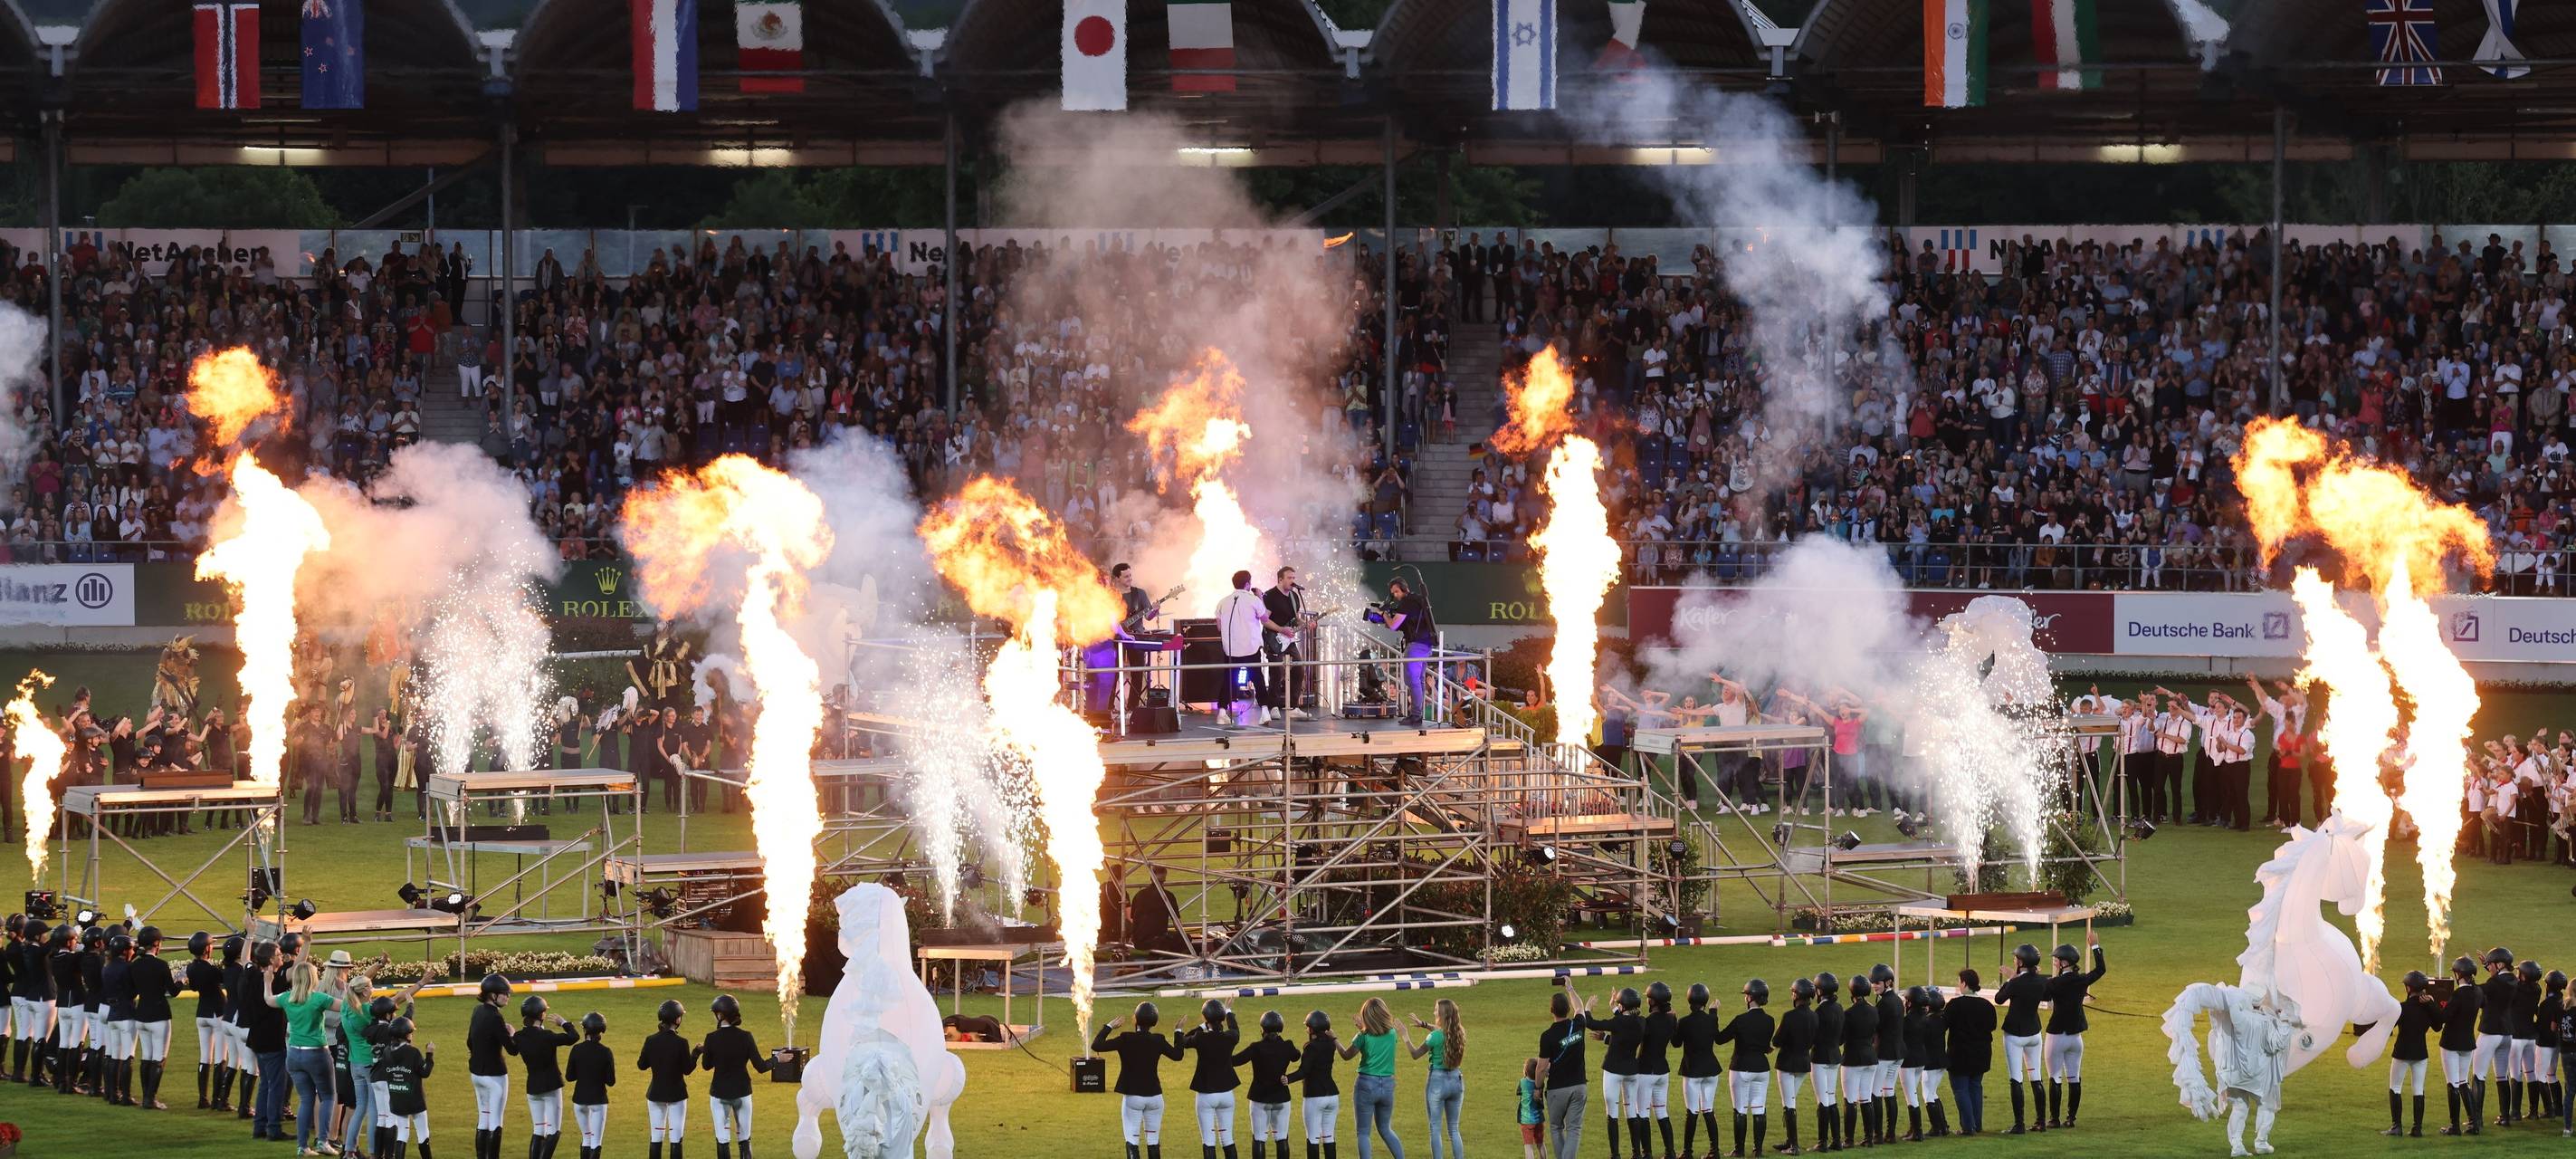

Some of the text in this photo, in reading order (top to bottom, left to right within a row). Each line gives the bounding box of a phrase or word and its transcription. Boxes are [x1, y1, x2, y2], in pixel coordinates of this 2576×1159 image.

[562, 600, 653, 618] ROLEX
[1679, 605, 1739, 632] Käfer
[2129, 621, 2255, 638] Deutsche Bank
